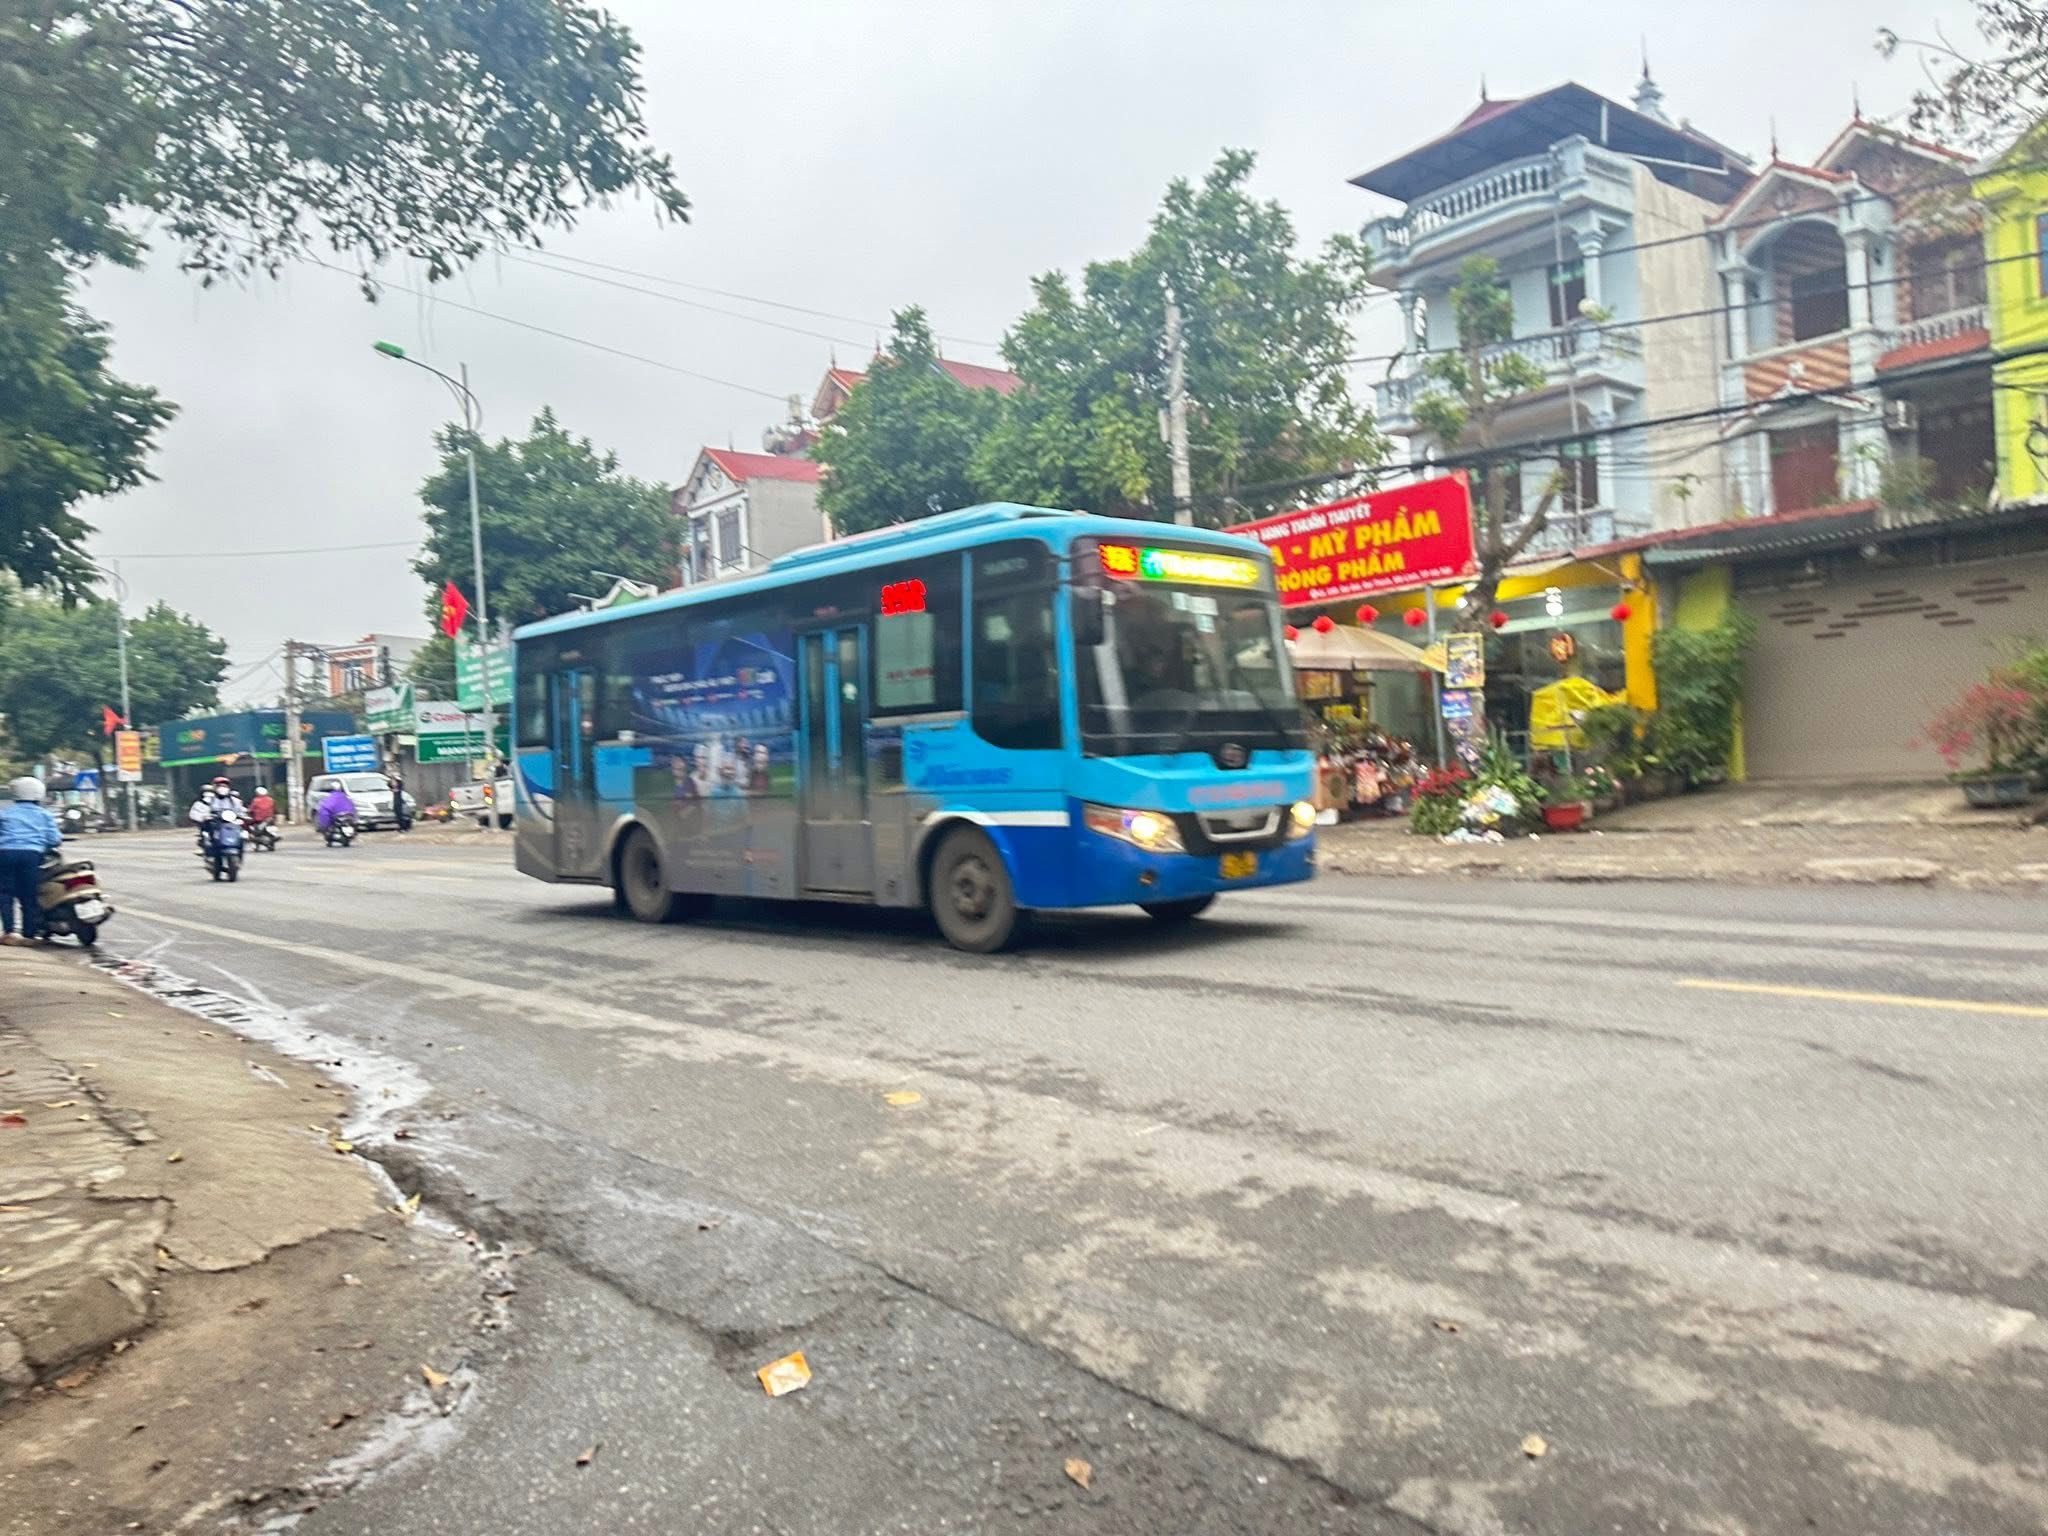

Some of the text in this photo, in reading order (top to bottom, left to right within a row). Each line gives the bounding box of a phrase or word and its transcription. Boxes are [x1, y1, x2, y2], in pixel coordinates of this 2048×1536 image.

[1355, 505, 1441, 550] PHẨM
[1275, 564, 1332, 593] HÒNG
[1337, 548, 1405, 581] PHẨM
